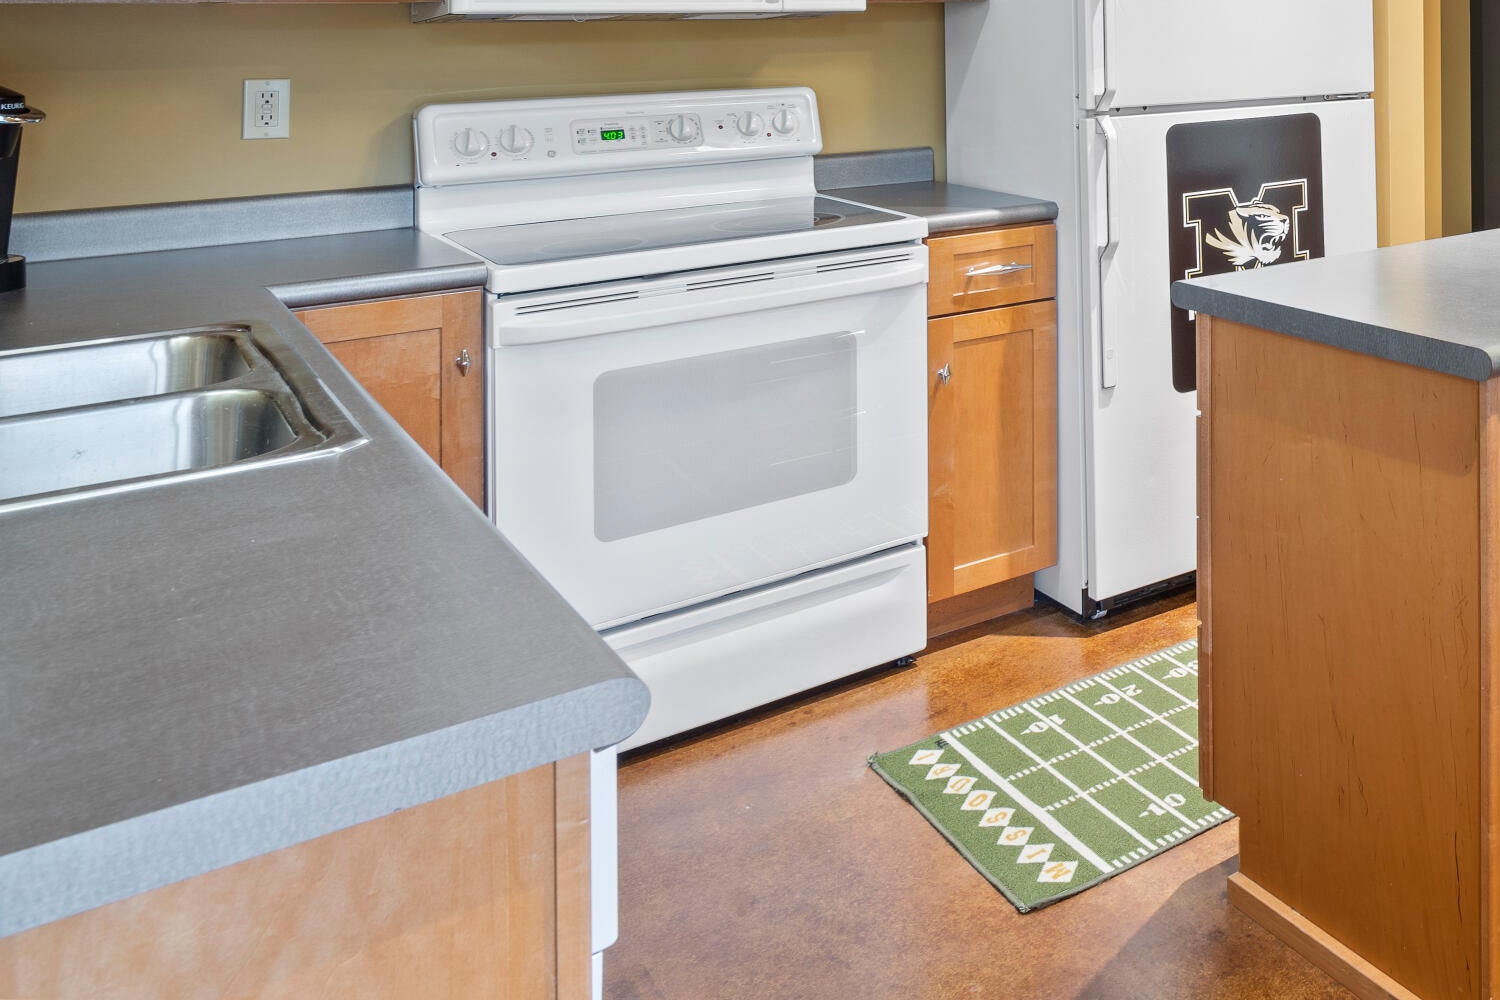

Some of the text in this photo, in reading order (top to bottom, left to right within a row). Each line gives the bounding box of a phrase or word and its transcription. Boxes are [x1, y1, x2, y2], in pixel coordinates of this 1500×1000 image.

[1100, 684, 1142, 705] 20
[1028, 714, 1066, 733] 10
[1147, 793, 1187, 816] 10
[917, 752, 1072, 880] MISSOURI
